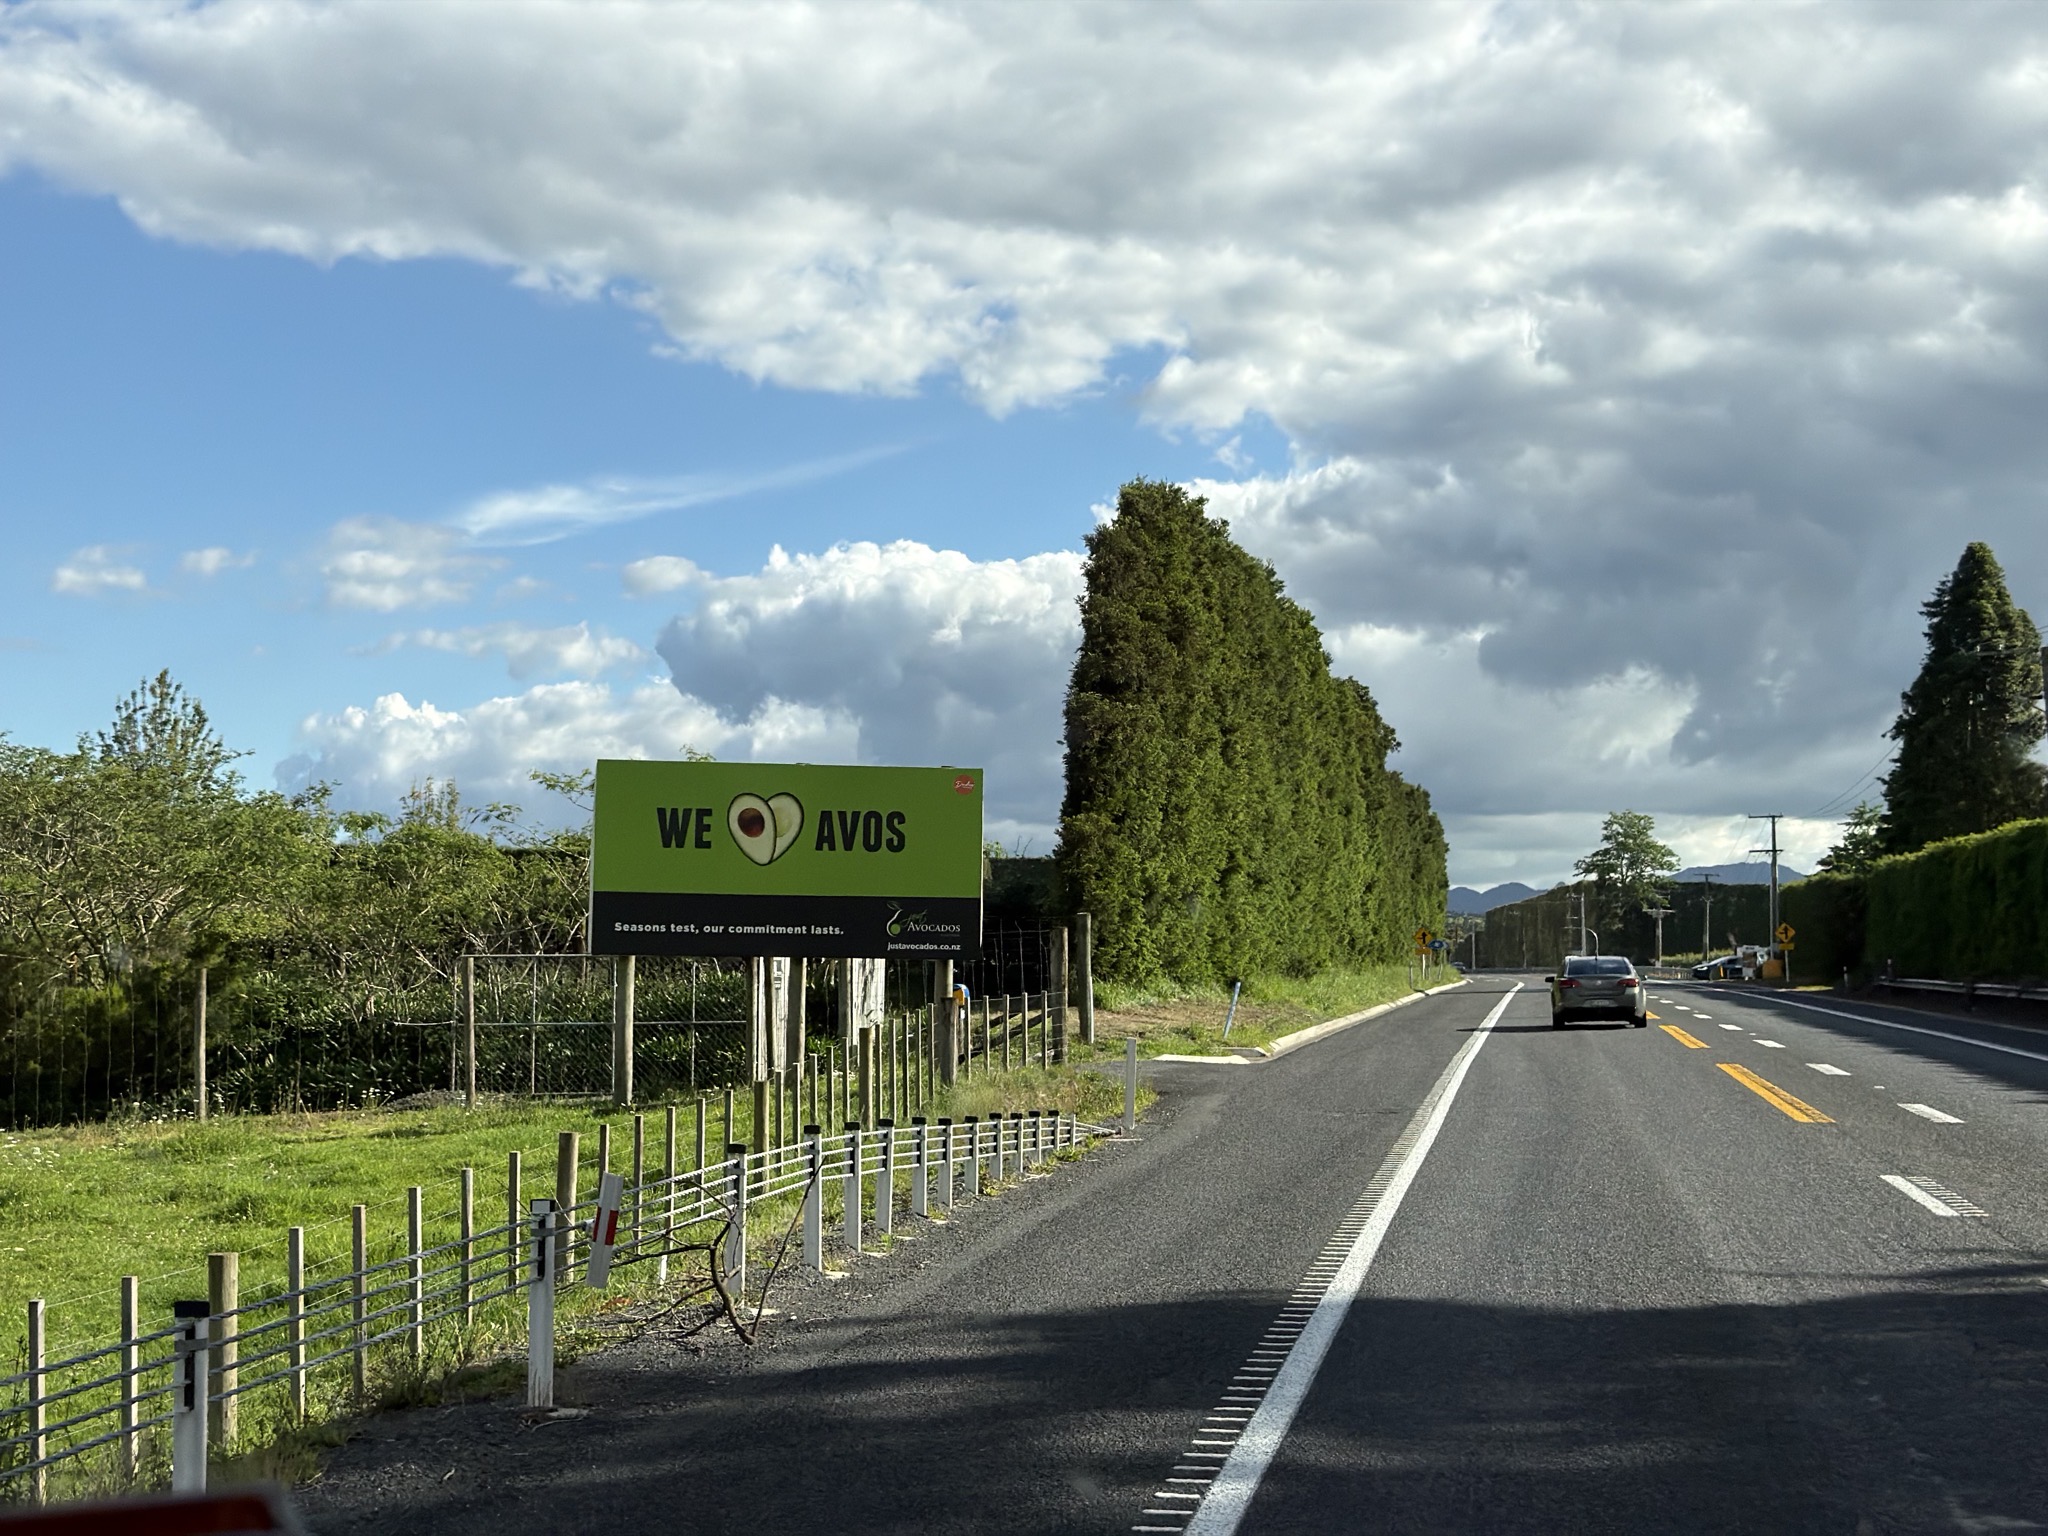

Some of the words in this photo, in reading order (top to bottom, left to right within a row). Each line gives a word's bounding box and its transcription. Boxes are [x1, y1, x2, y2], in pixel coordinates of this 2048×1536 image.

[656, 807, 713, 850] WE
[815, 810, 907, 853] AVOS
[614, 922, 667, 932] Seasons
[670, 923, 699, 934] test,
[703, 924, 725, 934] our
[728, 924, 807, 935] commitment
[811, 925, 845, 936] lasts.
[907, 922, 960, 932] AVOCADOS
[887, 942, 961, 951] justavocados.co.nz
